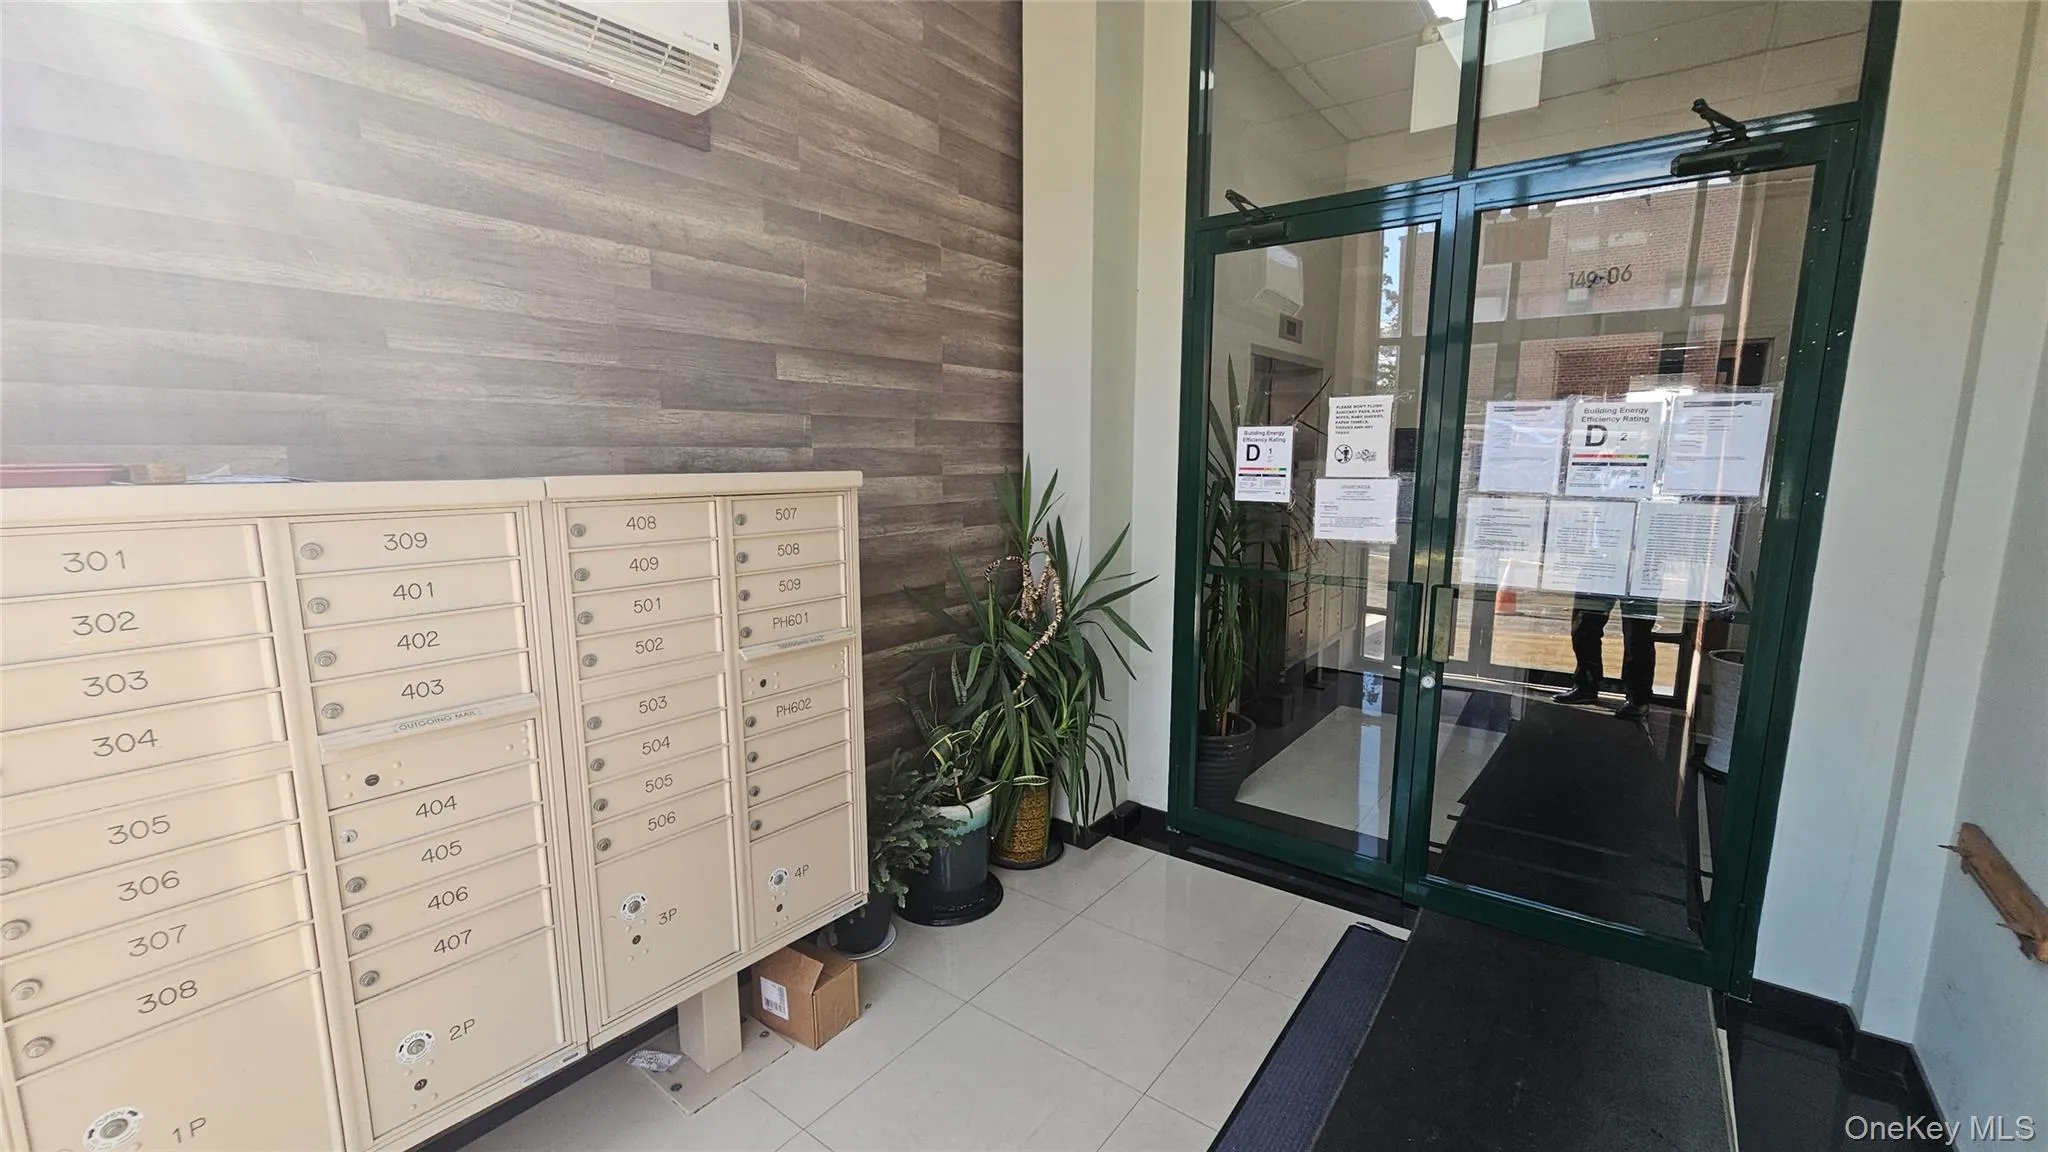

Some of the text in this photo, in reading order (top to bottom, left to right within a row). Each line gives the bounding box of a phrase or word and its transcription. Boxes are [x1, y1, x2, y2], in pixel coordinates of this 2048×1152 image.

[1568, 264, 1633, 289] 149-06
[1581, 416, 1621, 424] Efficiency
[1583, 407, 1649, 415] Building Energy
[1585, 424, 1608, 447] D
[1620, 432, 1628, 441] 2
[1246, 443, 1261, 461] D
[626, 516, 657, 531] 408
[775, 508, 798, 521] 507
[384, 532, 428, 551] 309
[777, 543, 800, 557] 508
[61, 550, 127, 573] 301
[629, 557, 659, 572] 409
[392, 582, 434, 600] 401
[778, 578, 801, 592] 509
[633, 597, 662, 614] 501
[71, 611, 139, 636] 302
[772, 612, 808, 629] PH601
[397, 630, 440, 651] 402
[635, 637, 664, 655] 502
[82, 670, 149, 697] 303
[401, 679, 444, 699] 403
[638, 695, 668, 714] 503
[776, 697, 812, 717] PH602
[398, 711, 477, 731] OUTGOING MAIL
[92, 729, 159, 757] 304
[641, 736, 671, 755] 504
[645, 773, 674, 793] 505
[415, 795, 458, 818] 404
[107, 815, 171, 845] 305
[648, 811, 676, 831] 506
[421, 839, 463, 864] 405
[794, 864, 810, 878] 4P
[117, 870, 181, 901] 306
[427, 886, 469, 910] 406
[658, 907, 677, 926] 3P
[128, 924, 187, 957] 307
[433, 929, 472, 954] 407
[136, 980, 198, 1014] 308
[404, 1031, 425, 1044] OPEN
[449, 1018, 475, 1041] 2P
[171, 1117, 207, 1144] 1P
